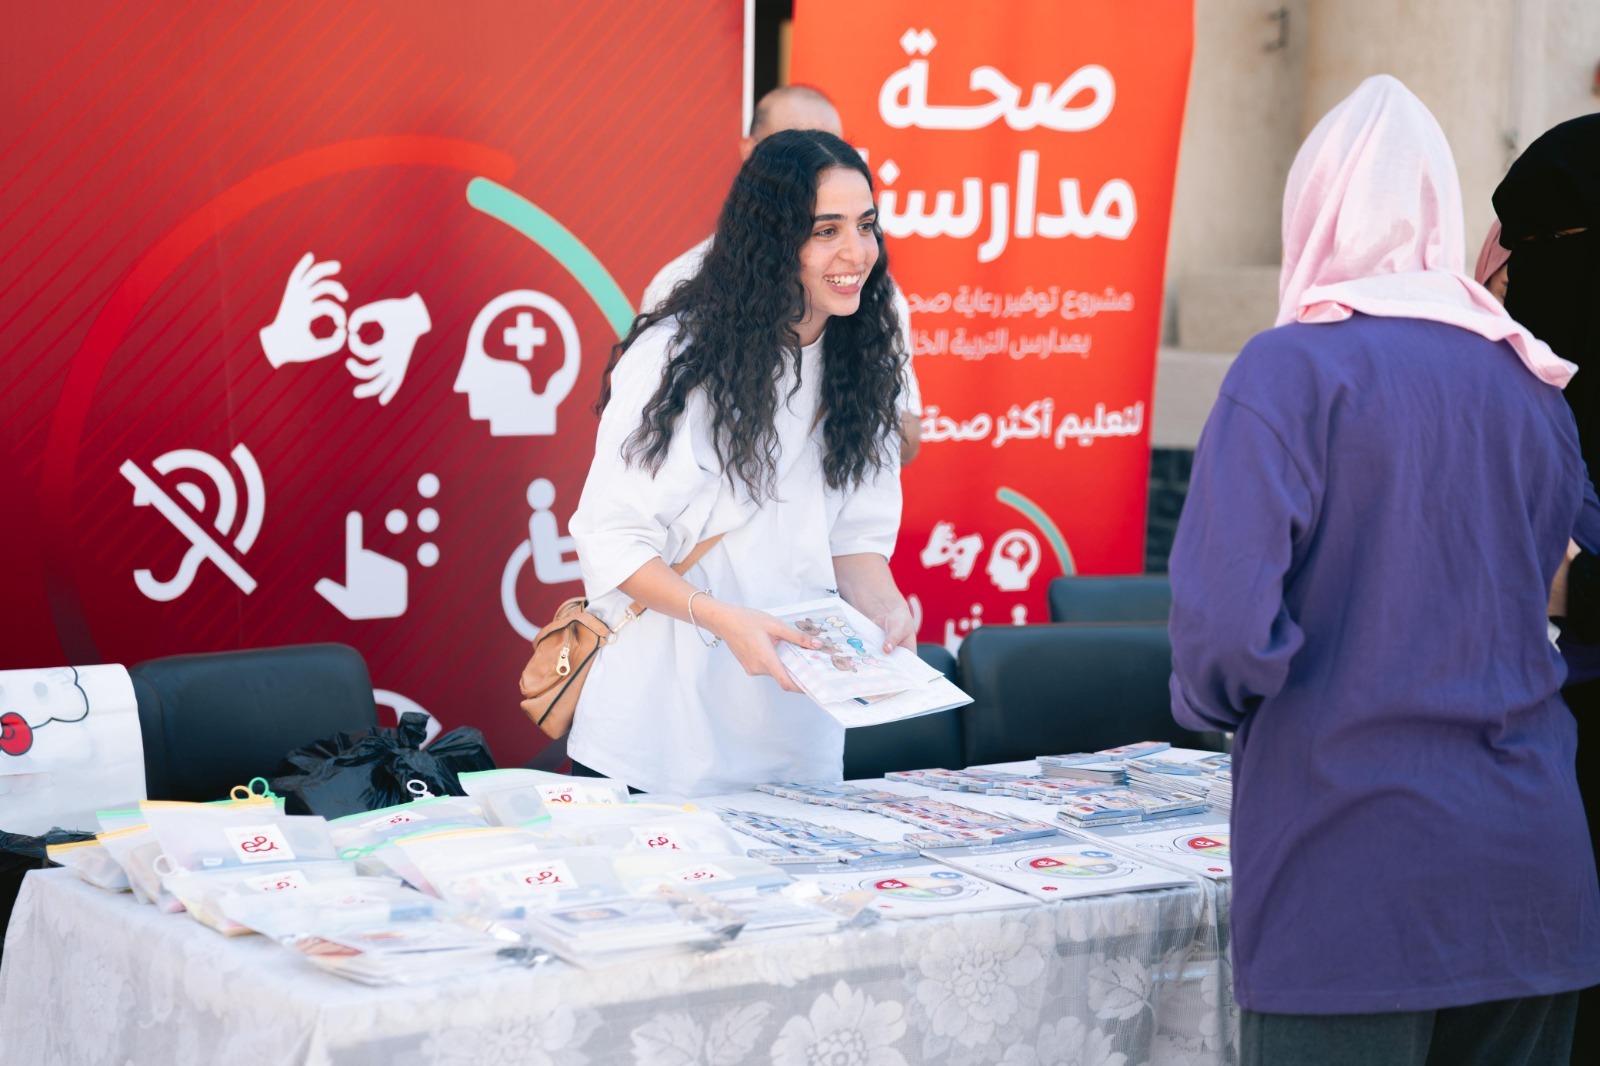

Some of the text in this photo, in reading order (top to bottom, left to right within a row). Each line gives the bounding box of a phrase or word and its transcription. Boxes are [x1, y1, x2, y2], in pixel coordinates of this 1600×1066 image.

[878, 28, 1116, 132] صحة
[855, 148, 1137, 263] مدارسن
[907, 285, 1134, 320] مشروع توفير رعاية صح
[911, 327, 1092, 361] بمدارس التربية الخا
[920, 397, 1144, 449] لتعليم أكثر صحة
